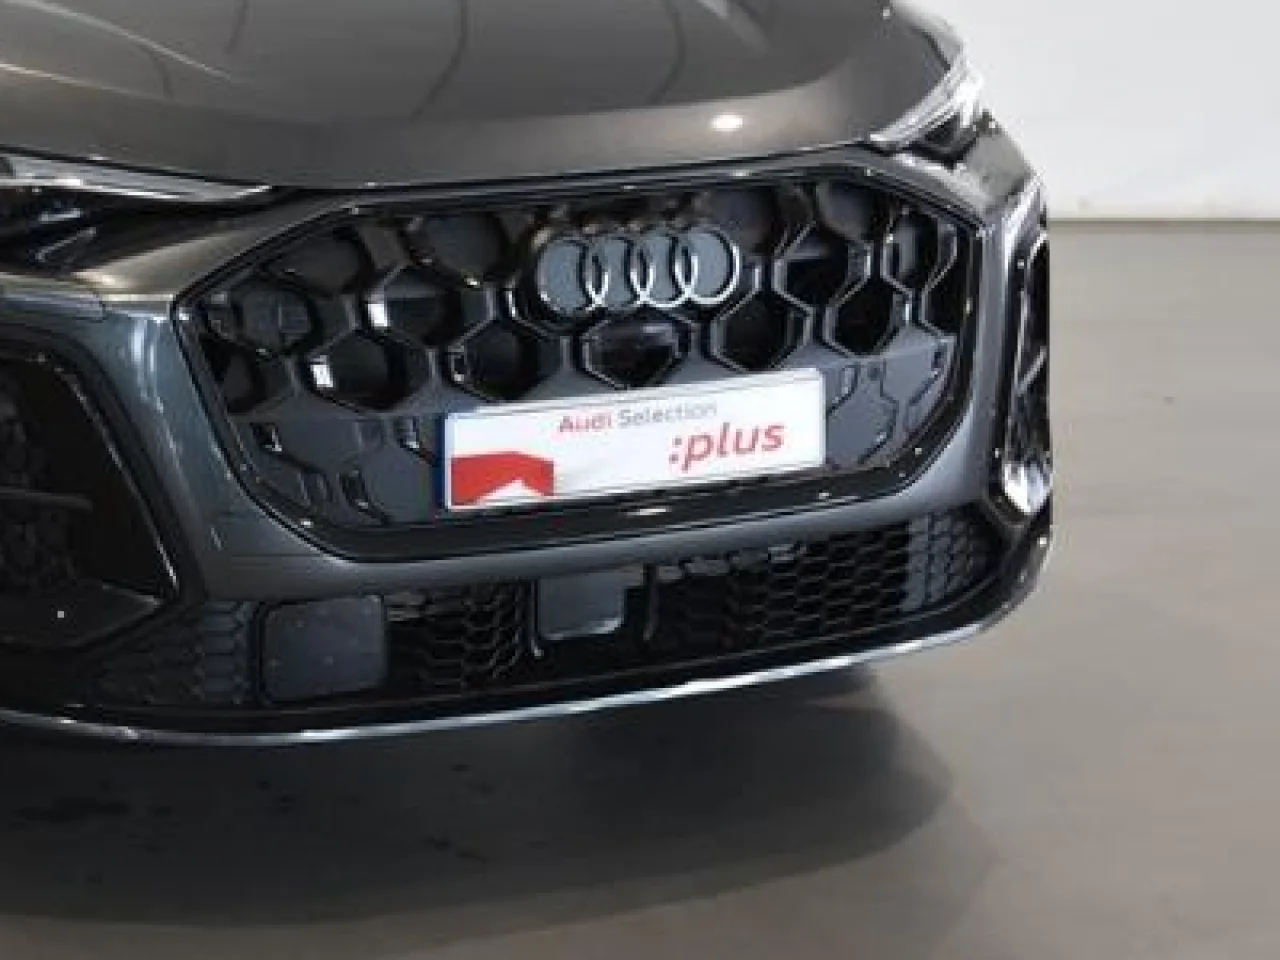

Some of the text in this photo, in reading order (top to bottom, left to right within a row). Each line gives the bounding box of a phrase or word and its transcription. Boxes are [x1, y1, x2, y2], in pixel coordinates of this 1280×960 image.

[558, 399, 718, 434] Audi Selection
[668, 422, 785, 472] :plus
